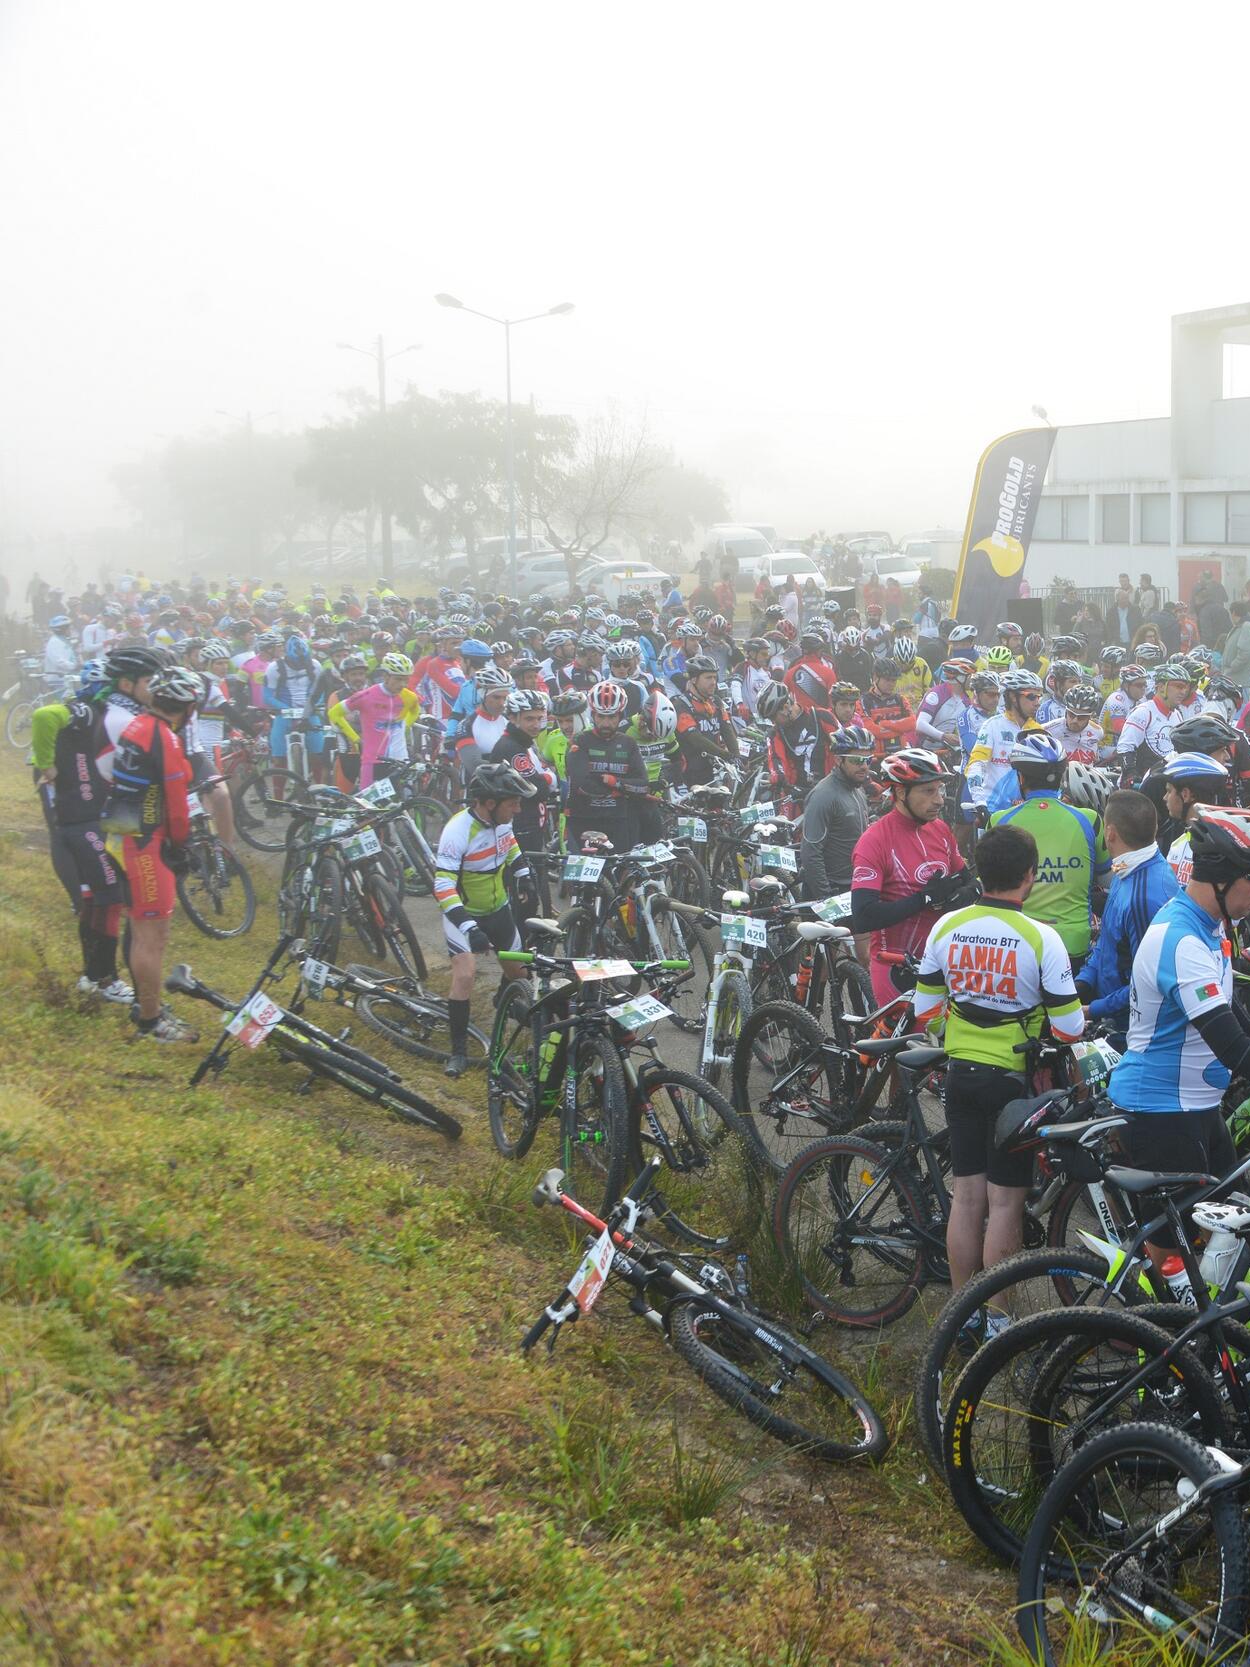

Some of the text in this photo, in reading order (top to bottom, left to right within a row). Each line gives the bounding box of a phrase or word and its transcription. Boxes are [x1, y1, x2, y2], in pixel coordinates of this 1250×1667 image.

[991, 456, 1025, 548] PROGOLD
[583, 867, 599, 877] 210
[746, 931, 765, 942] 420
[951, 932, 1021, 949] Maratona BTT
[948, 943, 1018, 977] CANHA
[947, 970, 1018, 1000] 2014
[258, 1003, 278, 1025] 652
[642, 1003, 666, 1017] 331
[952, 1399, 969, 1467] MAXXIS
